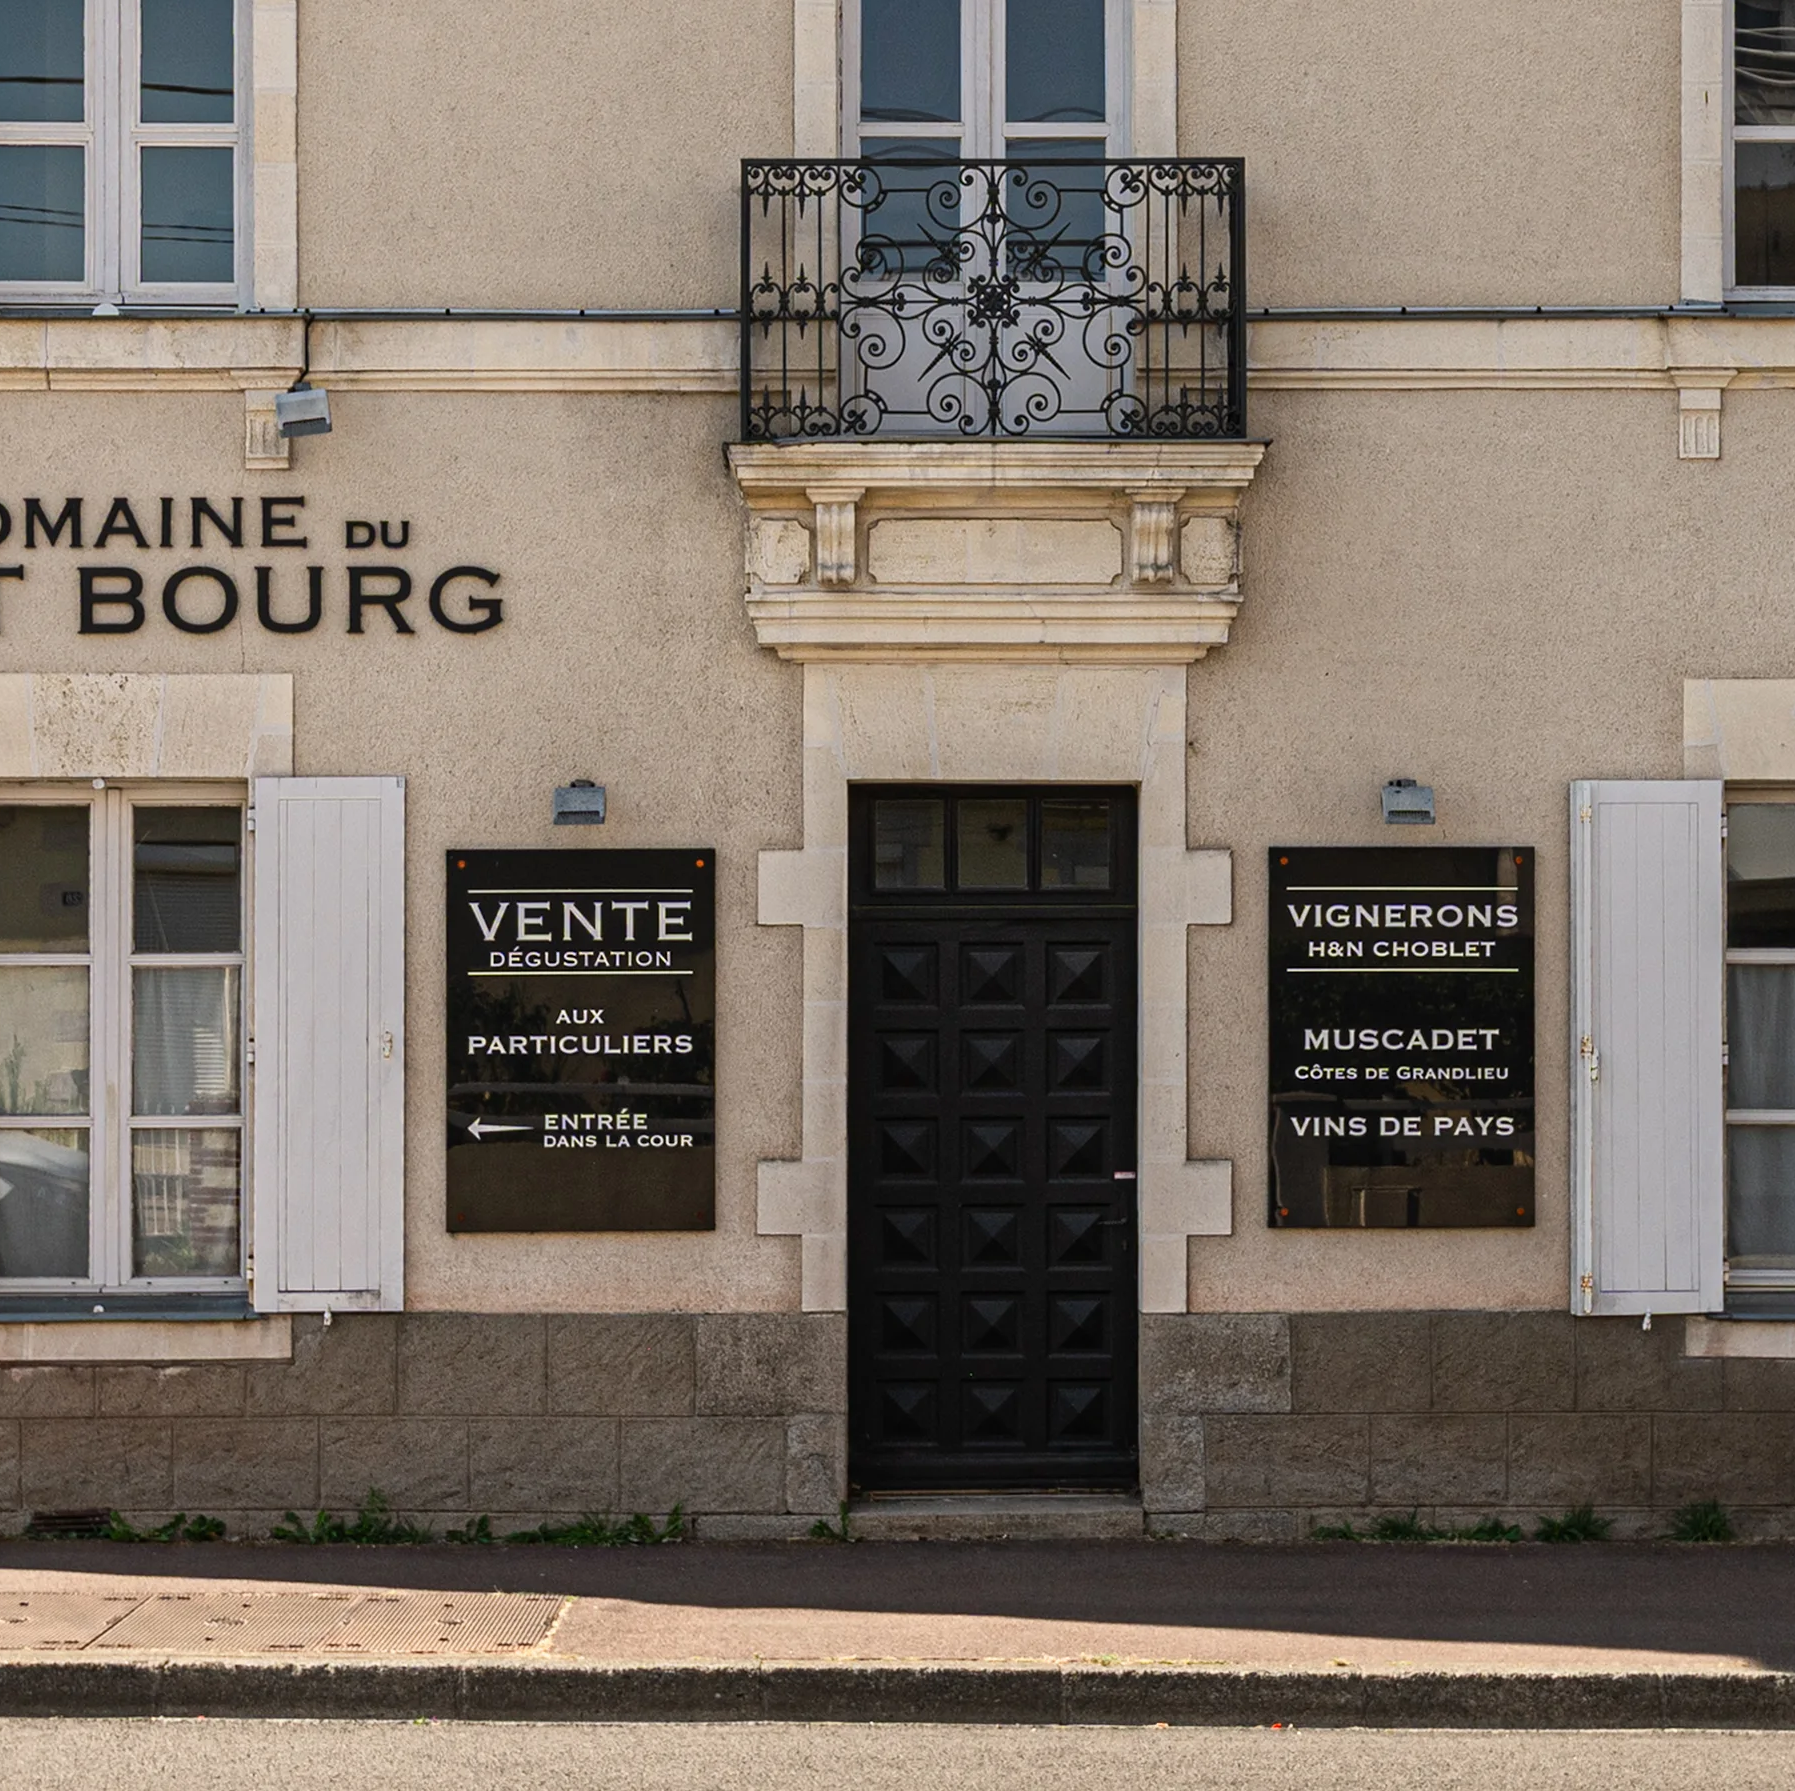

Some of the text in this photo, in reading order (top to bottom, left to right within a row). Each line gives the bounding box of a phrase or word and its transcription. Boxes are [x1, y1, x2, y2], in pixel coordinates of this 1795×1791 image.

[344, 520, 410, 550] DU
[77, 565, 504, 636] BOURG
[468, 900, 693, 942] VENTE
[1287, 904, 1519, 928] VIGNERONS
[489, 945, 671, 968] DÉGUSTATION
[1308, 941, 1496, 957] H&N CHOBLET
[555, 1009, 605, 1025] AUX
[468, 1034, 694, 1055] PARTICULIERS
[1304, 1028, 1500, 1051] MUSCADET
[1294, 1063, 1510, 1080] CÔTES DE GRANDLIEU
[543, 1107, 648, 1130] ENTRÉE
[1290, 1116, 1515, 1137] VINS DE PAYS
[543, 1134, 694, 1148] DANS LA COUR
